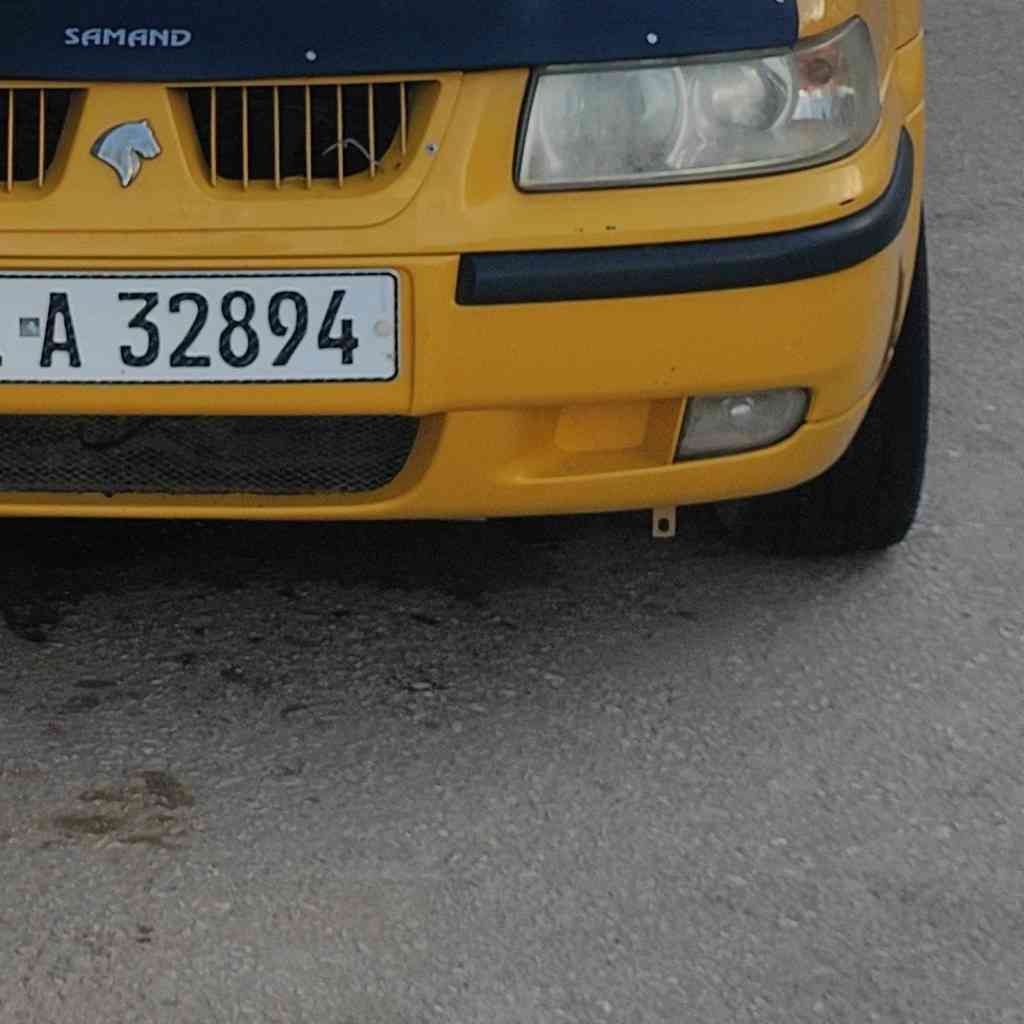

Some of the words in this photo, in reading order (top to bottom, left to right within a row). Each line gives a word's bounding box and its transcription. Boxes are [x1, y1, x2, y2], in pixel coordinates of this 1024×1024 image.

[64, 27, 192, 47] SAMAND
[40, 292, 82, 368] A
[118, 290, 359, 368] 32894
